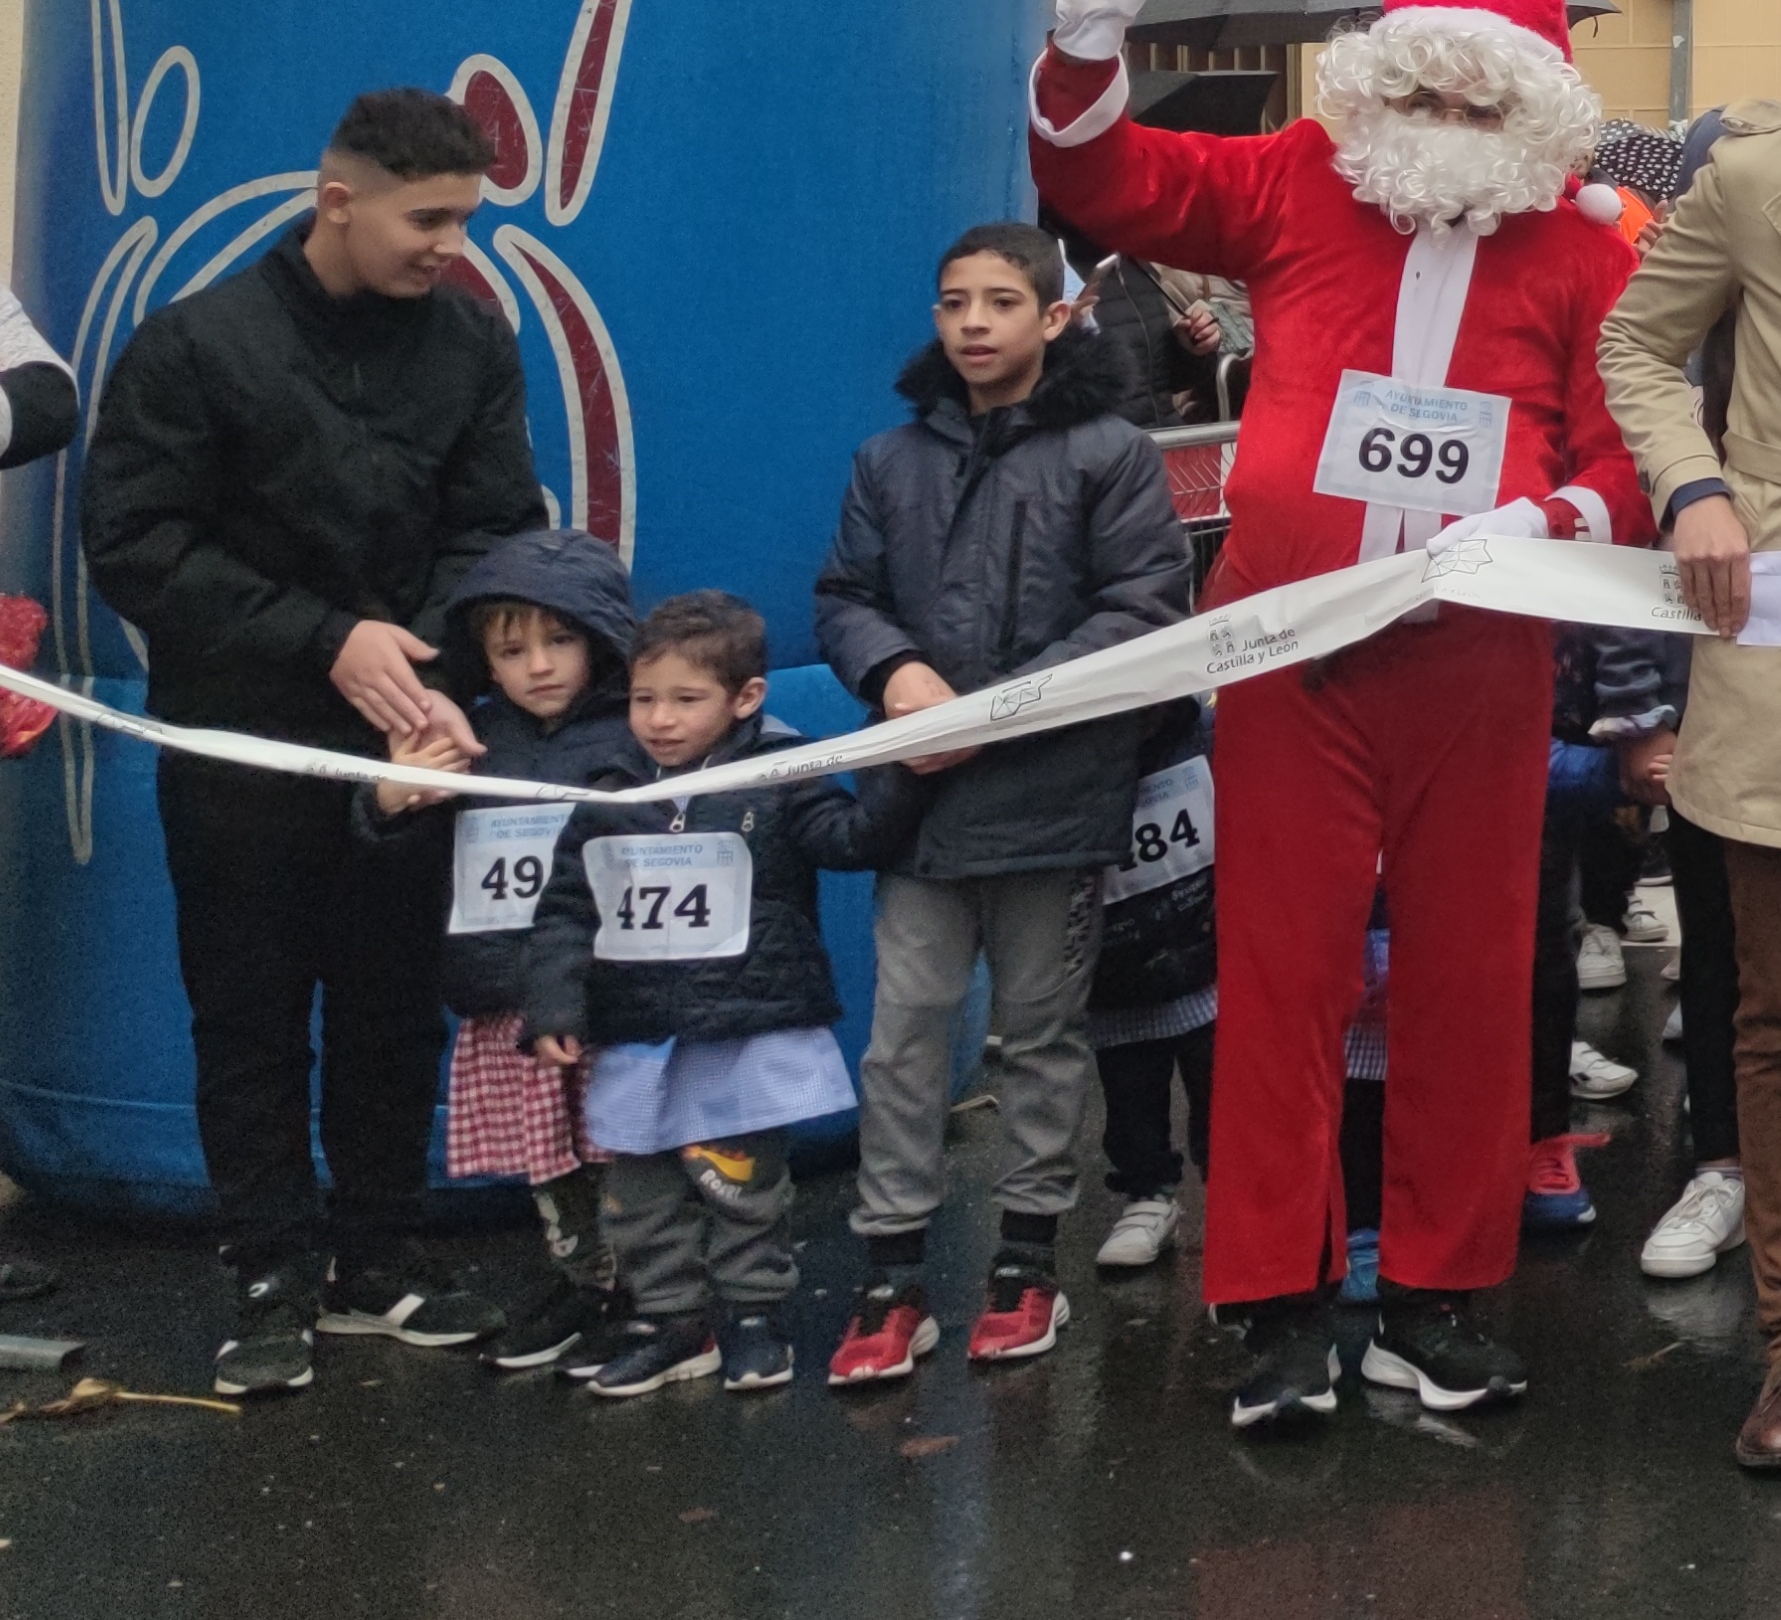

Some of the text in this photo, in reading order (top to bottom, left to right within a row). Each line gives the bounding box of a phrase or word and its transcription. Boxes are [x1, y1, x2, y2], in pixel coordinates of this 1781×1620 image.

[1408, 408, 1458, 423] SEGOVIA
[1359, 427, 1469, 484] 699
[1206, 639, 1300, 674] Castilla y León
[1240, 627, 1296, 654] Junta de
[490, 813, 567, 828] AYUNTAMIENT
[1119, 808, 1201, 872] 84
[481, 855, 544, 900] 49
[643, 857, 692, 867] SEGOVIA
[616, 883, 711, 930] 474
